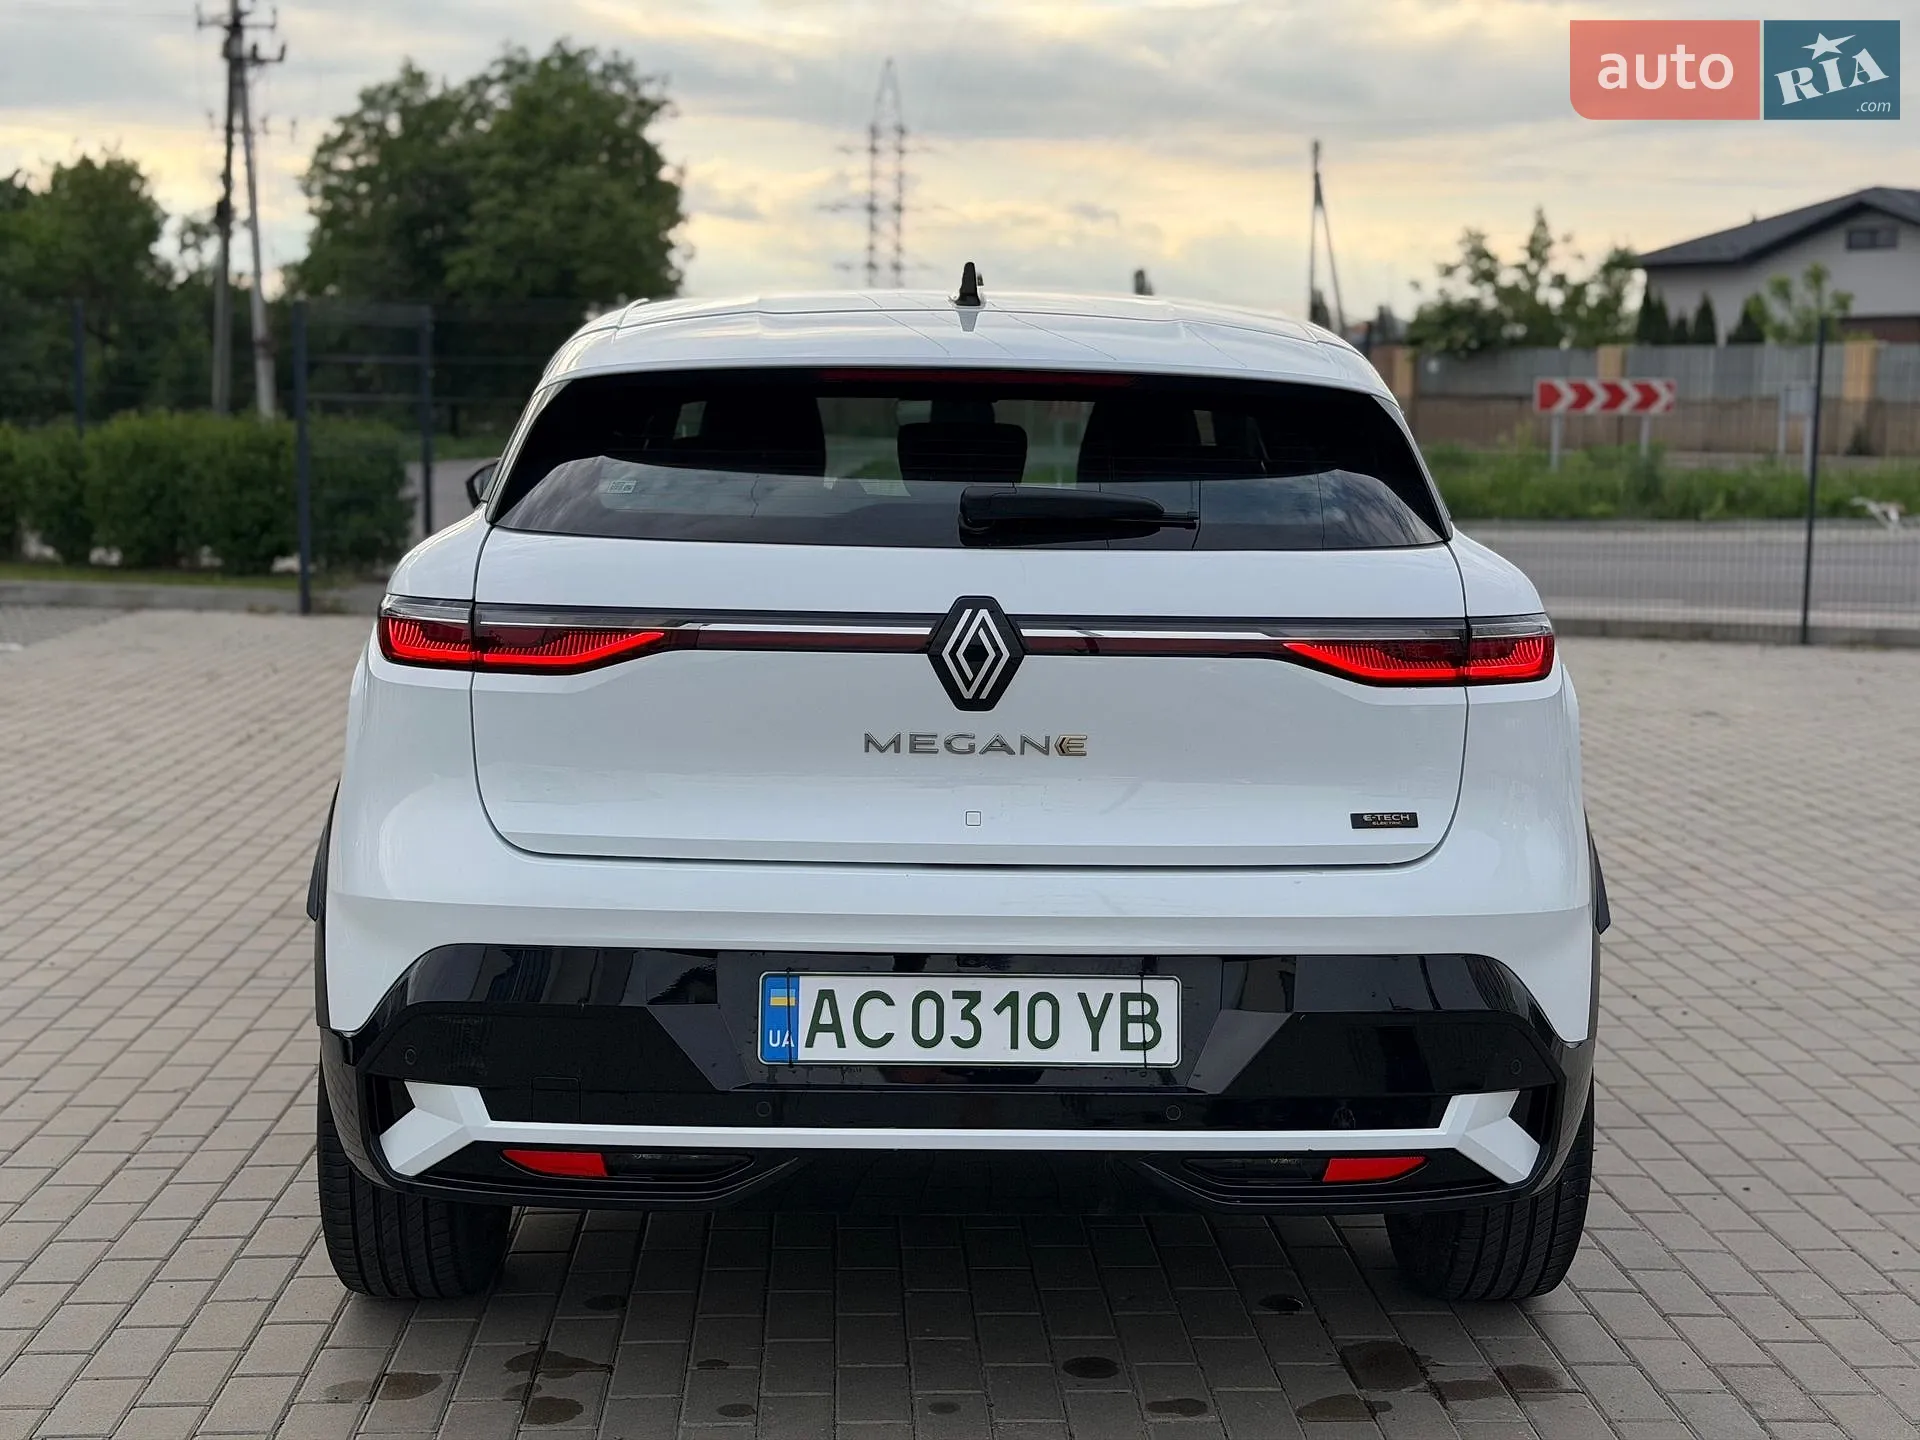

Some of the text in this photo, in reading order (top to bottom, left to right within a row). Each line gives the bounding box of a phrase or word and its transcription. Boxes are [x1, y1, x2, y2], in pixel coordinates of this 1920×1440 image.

[864, 731, 1088, 757] MEGANE
[804, 988, 1163, 1052] AC 0310 YB
[769, 1030, 795, 1048] UA
